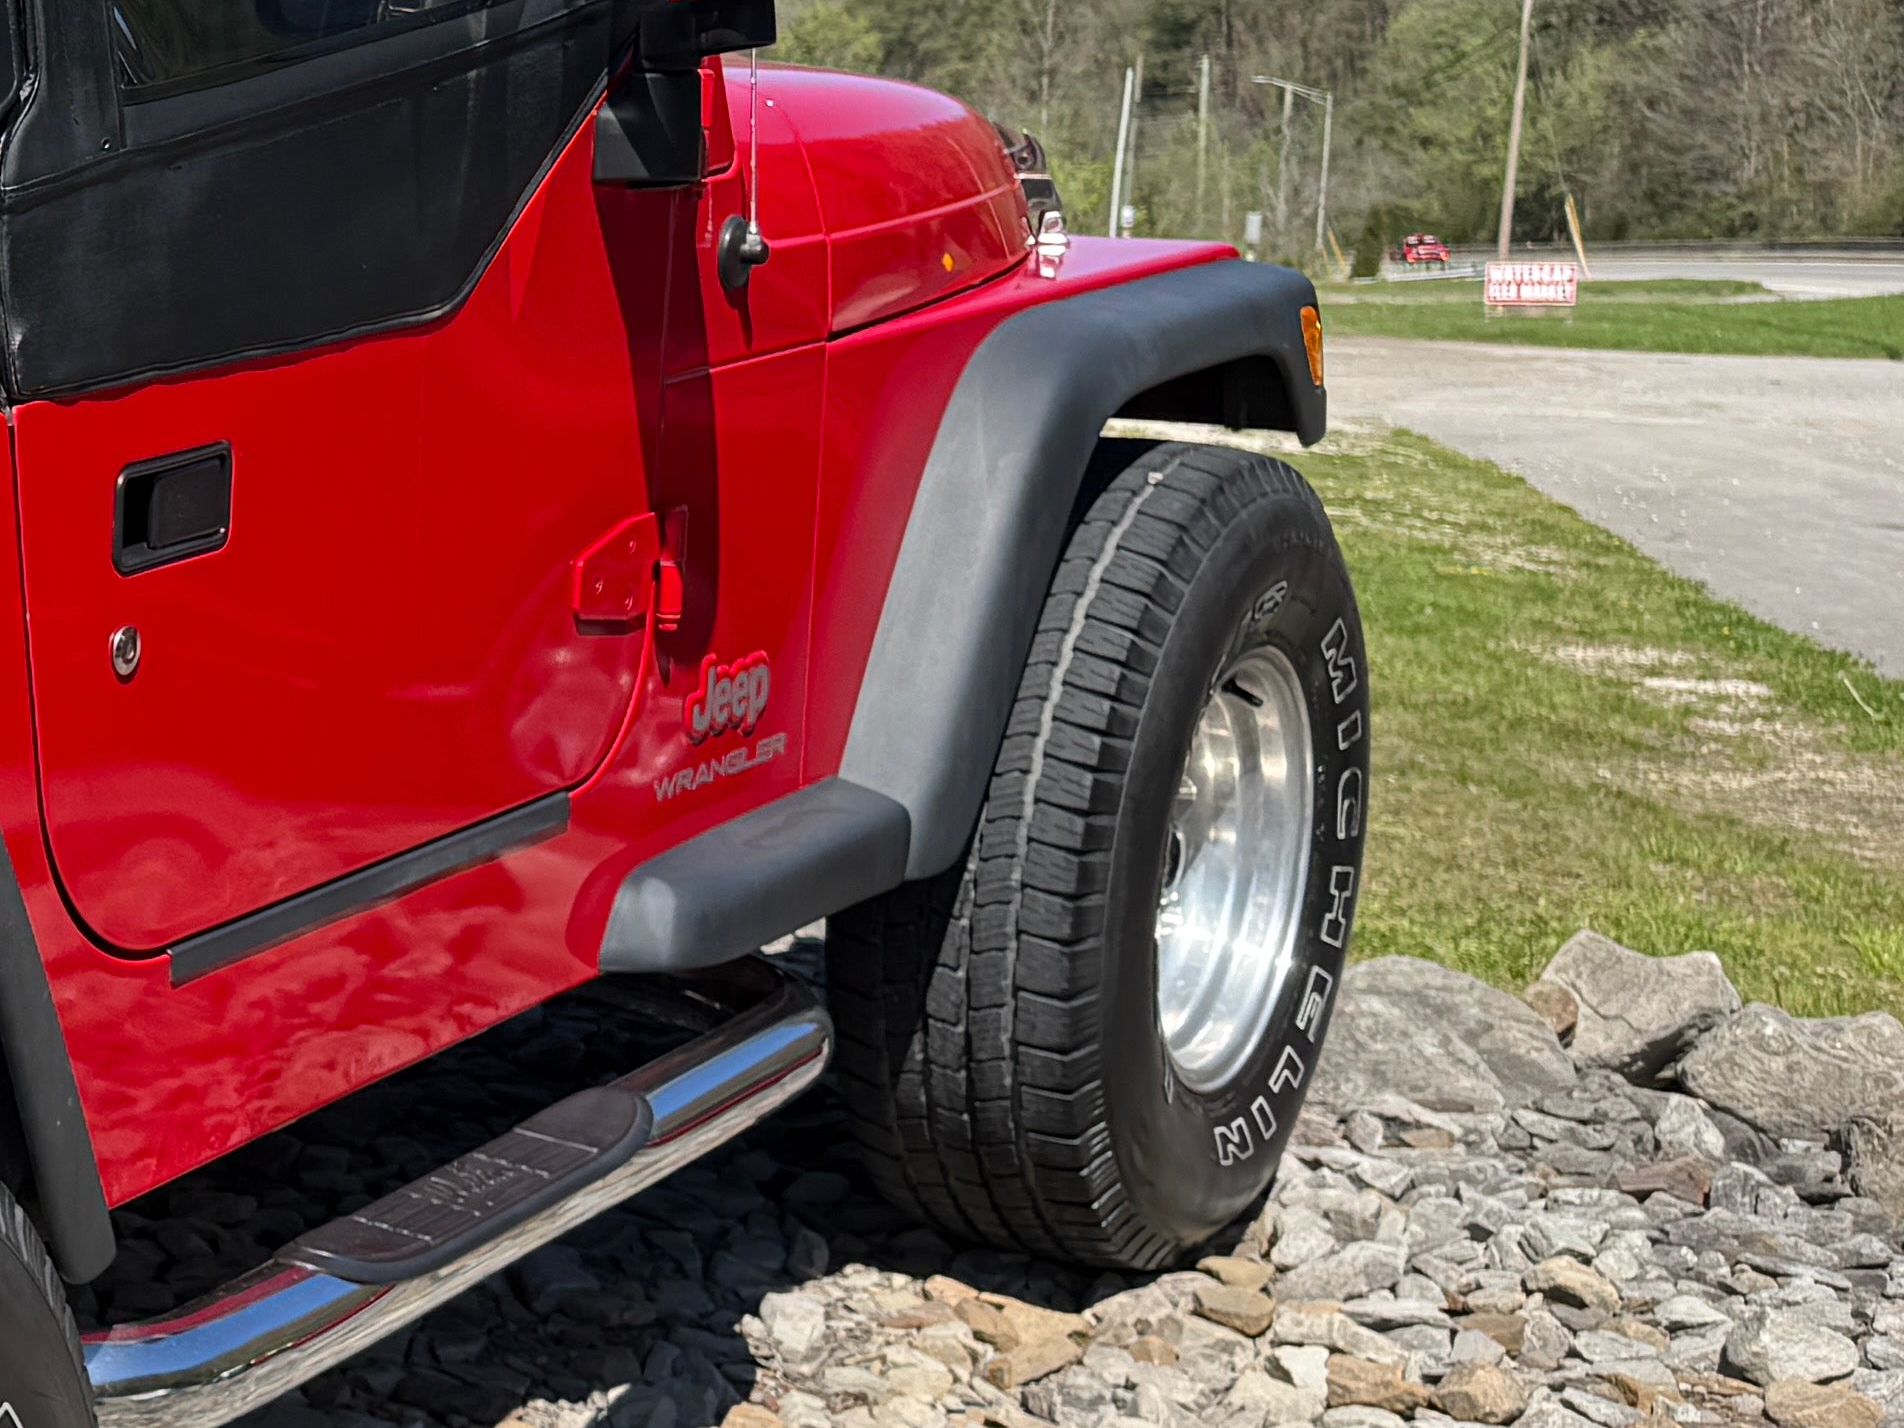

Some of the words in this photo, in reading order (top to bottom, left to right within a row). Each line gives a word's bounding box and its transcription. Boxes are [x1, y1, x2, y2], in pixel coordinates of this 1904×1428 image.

[688, 657, 770, 738] Jeep
[653, 732, 787, 803] WRANGLER
[1214, 617, 1363, 1166] MICHELIN
